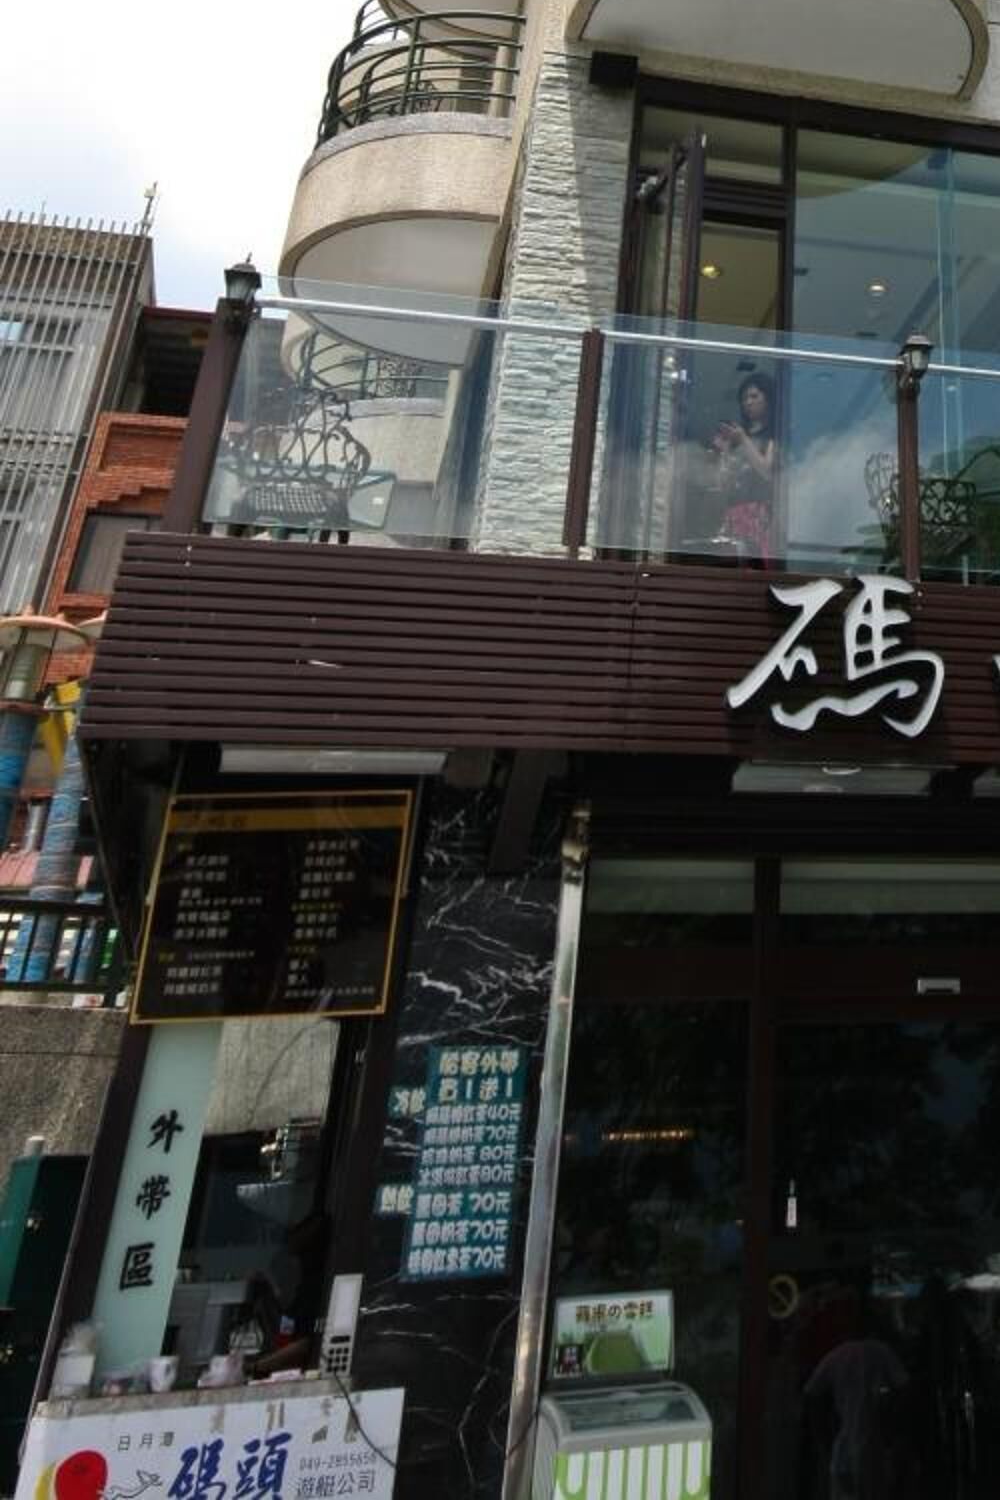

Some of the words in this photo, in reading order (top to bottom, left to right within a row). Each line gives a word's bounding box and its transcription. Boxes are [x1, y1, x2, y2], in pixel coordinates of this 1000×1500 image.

[119, 1109, 184, 1291] 外帶區
[168, 1431, 292, 1500] 碼頭
[296, 1469, 377, 1499] 遊艇公司
